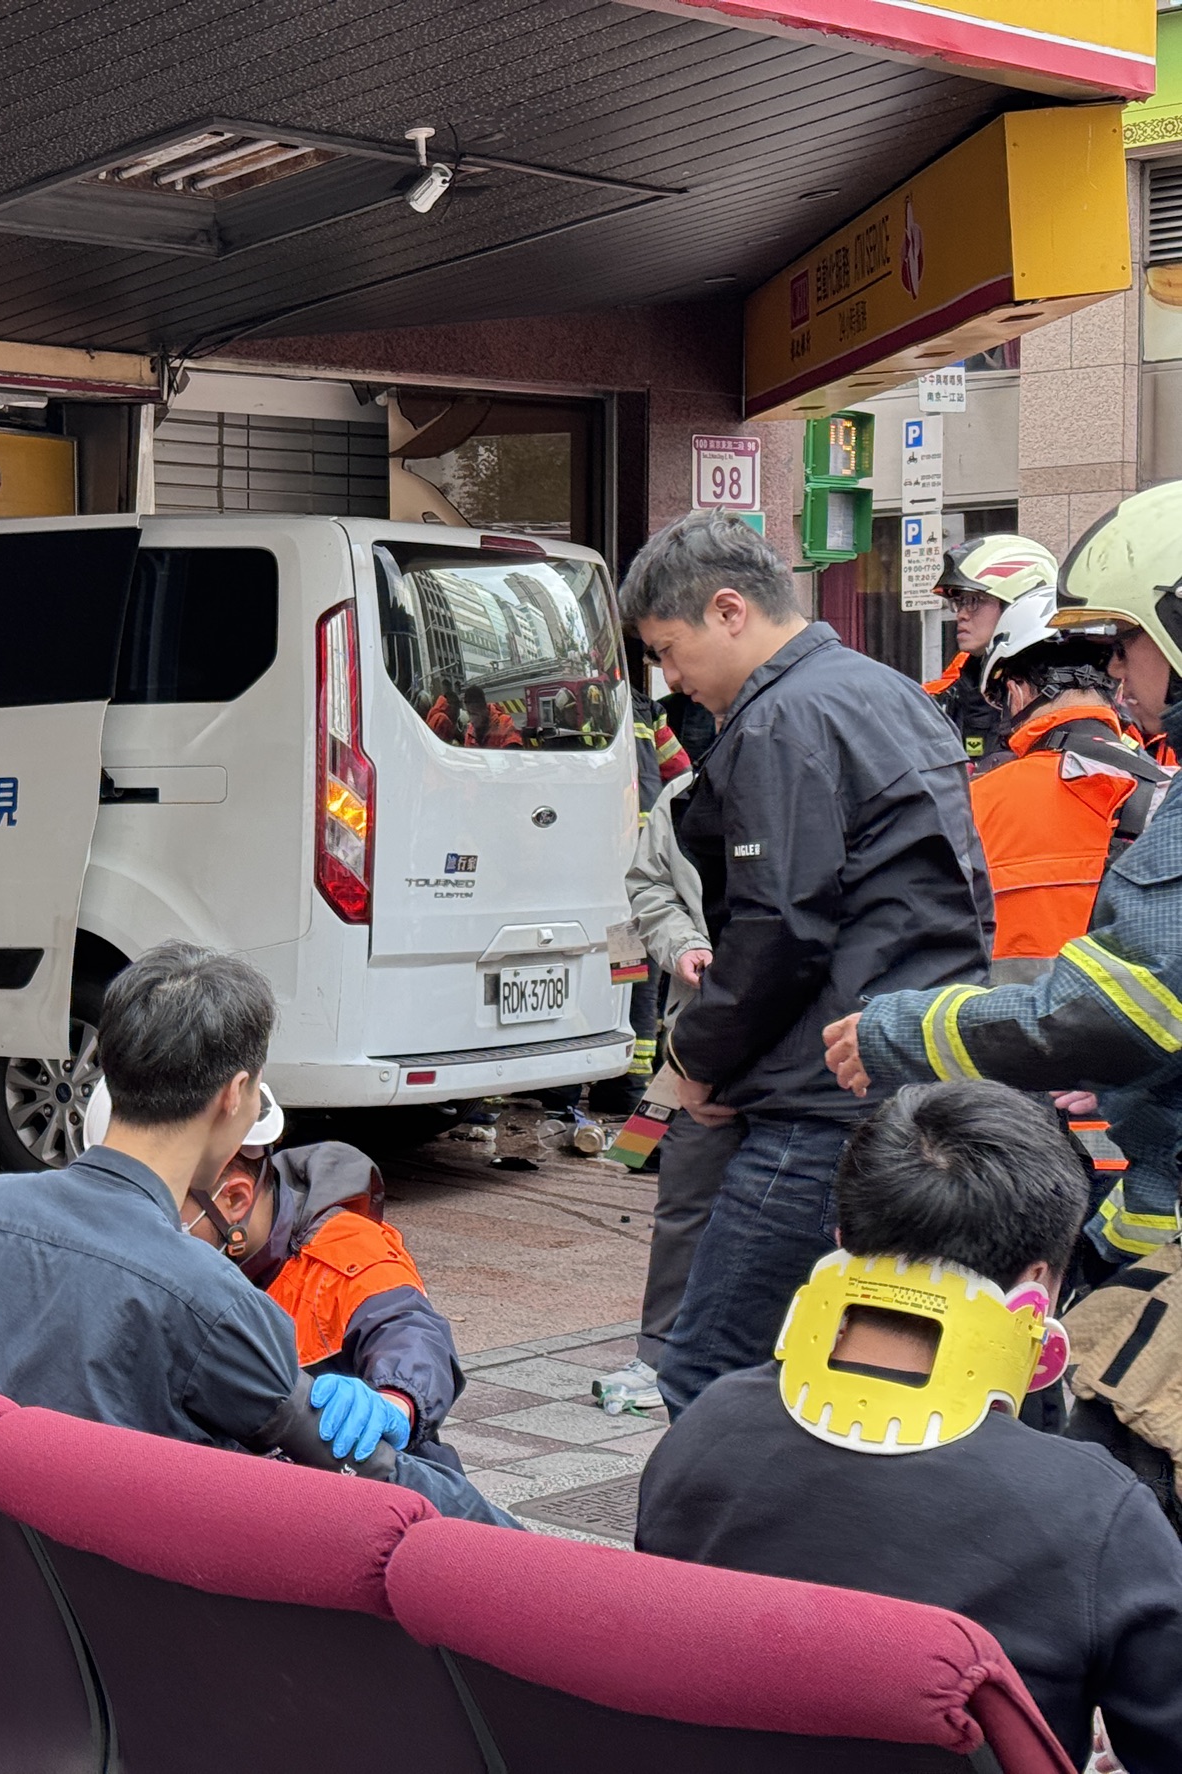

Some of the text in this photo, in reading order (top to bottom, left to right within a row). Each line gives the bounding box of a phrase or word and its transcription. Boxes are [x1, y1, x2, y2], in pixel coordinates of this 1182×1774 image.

[695, 439, 707, 449] 100
[908, 425, 920, 445] P
[712, 466, 741, 500] 98
[907, 523, 919, 542] P
[405, 878, 475, 888] TOURNEO
